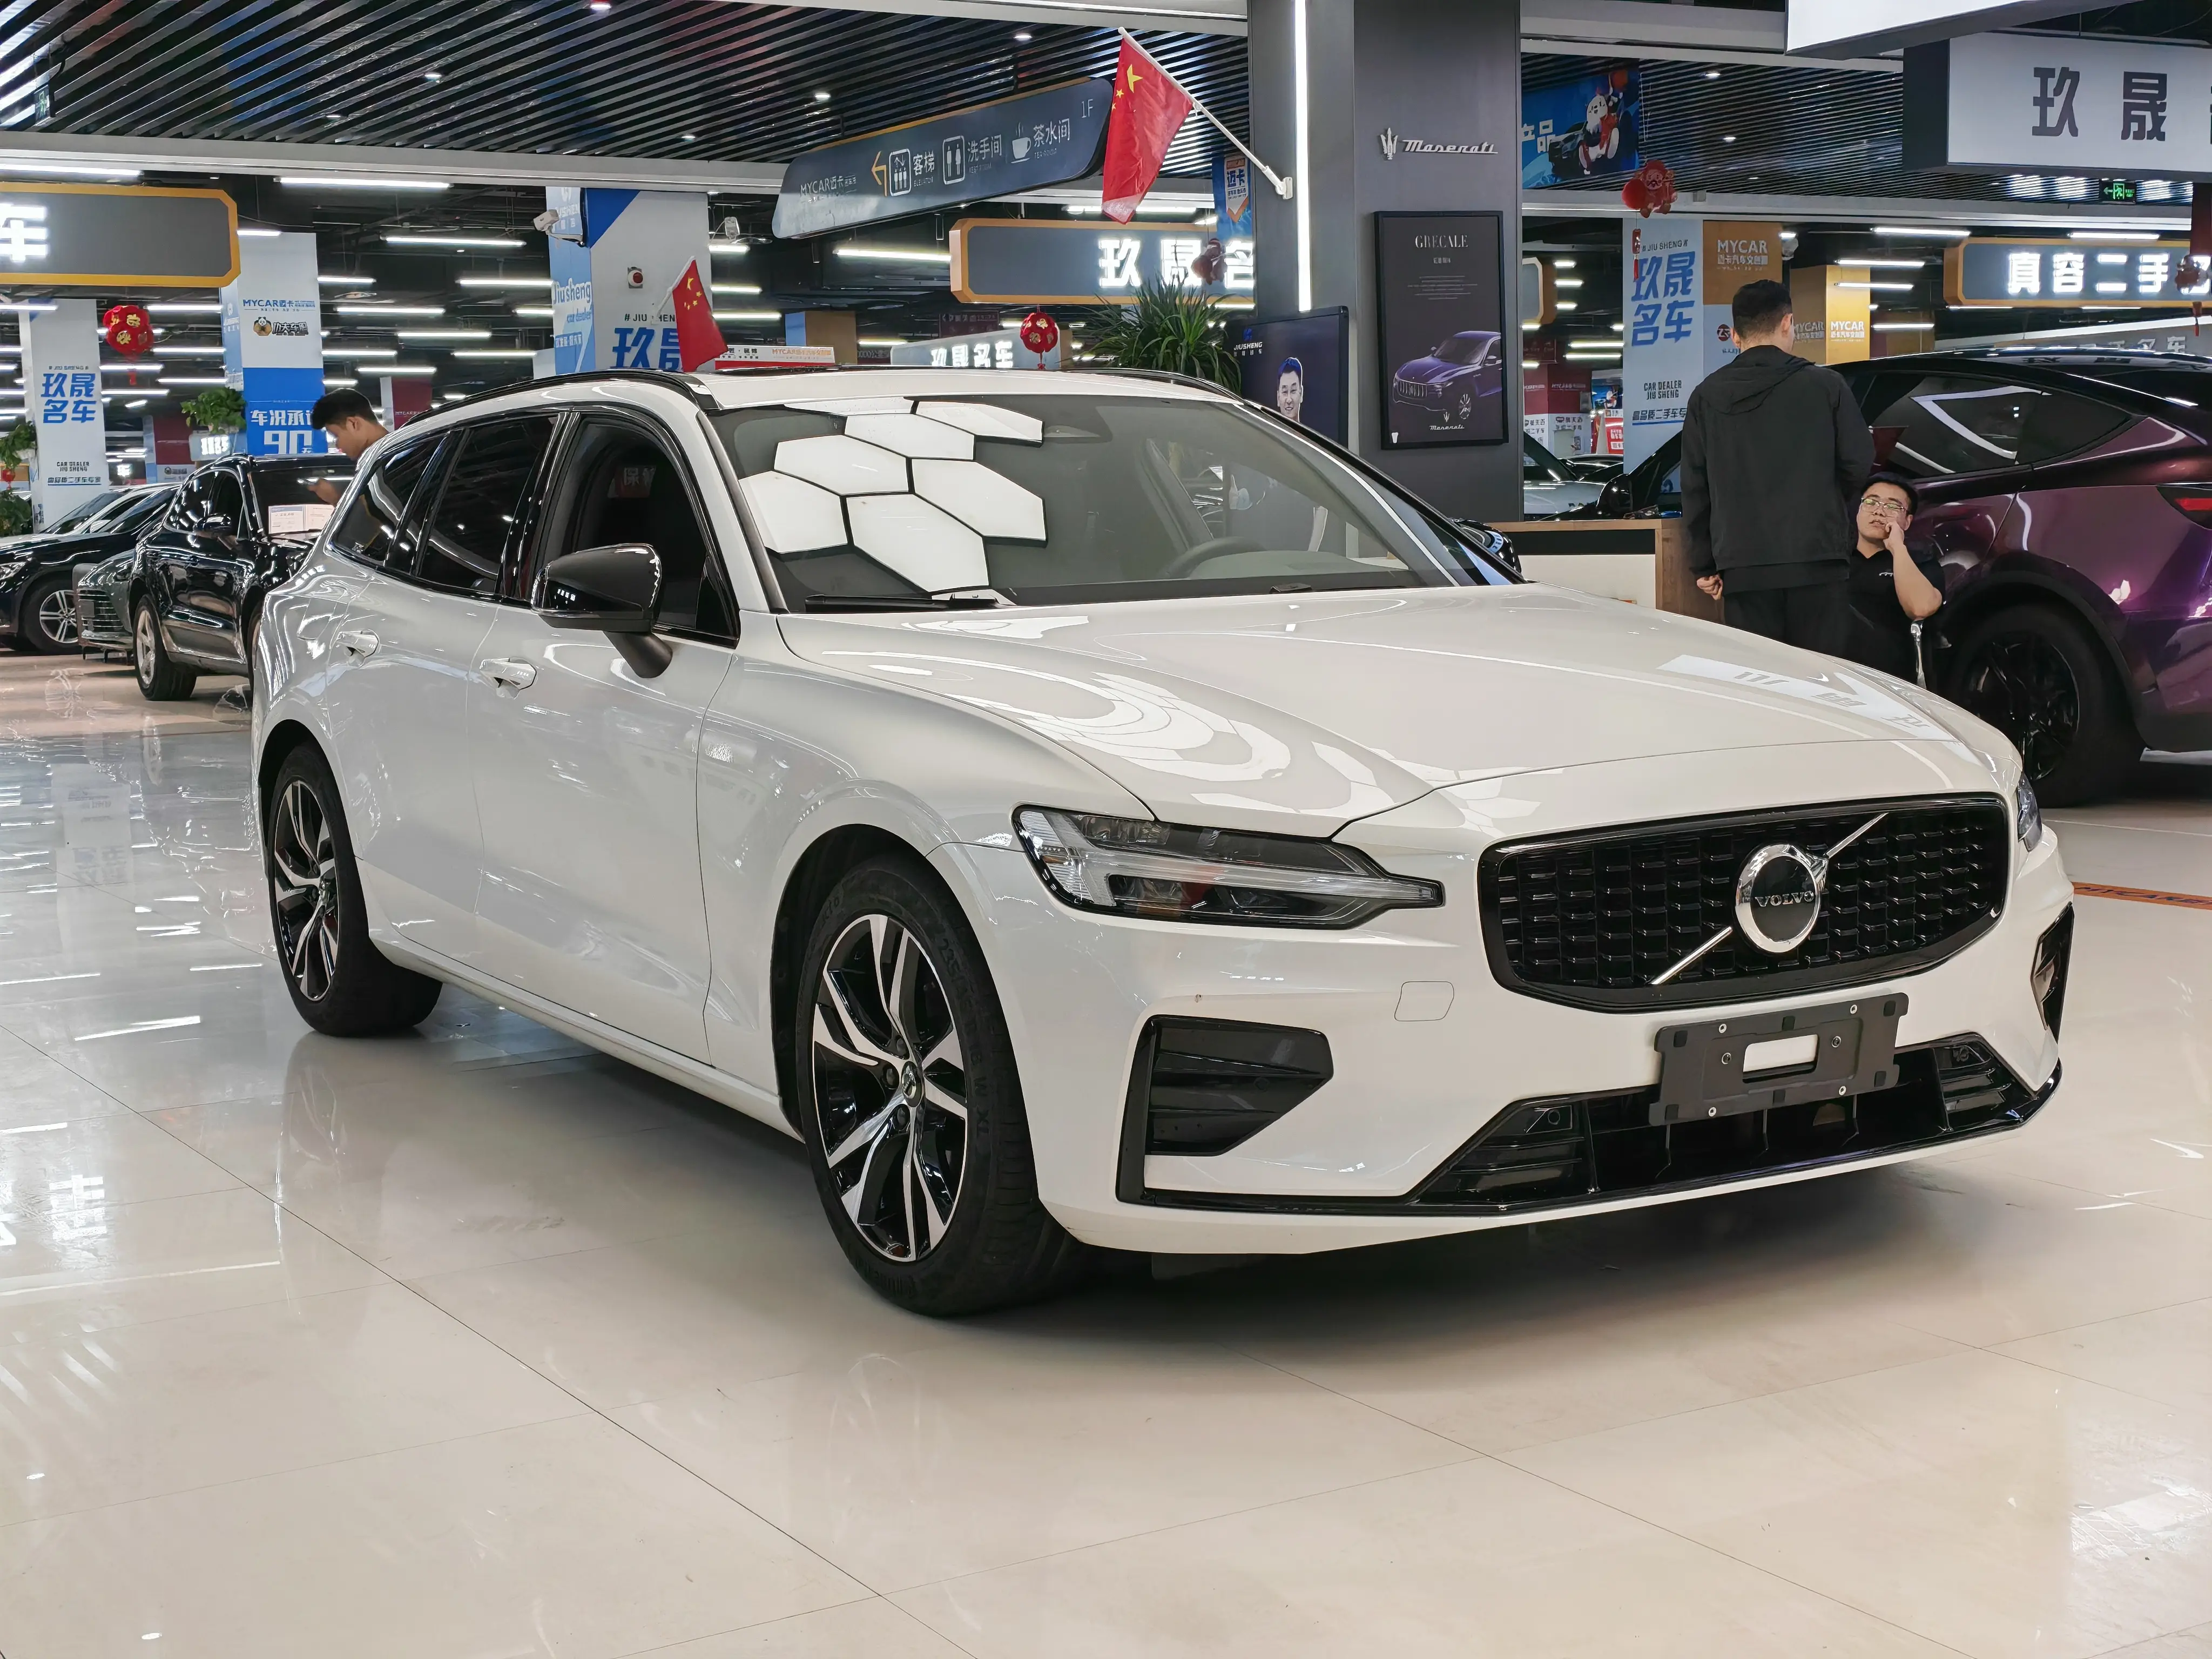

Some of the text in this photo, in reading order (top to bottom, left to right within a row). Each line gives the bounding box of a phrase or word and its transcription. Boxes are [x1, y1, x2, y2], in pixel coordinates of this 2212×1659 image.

[1082, 99, 1093, 118] 1F
[2032, 67, 2212, 143] 玖晟
[1033, 118, 1070, 147] 茶水间
[968, 134, 1002, 163] 洗手间
[1402, 139, 1498, 154] Maserati
[913, 150, 935, 176] 客梯
[1415, 235, 1468, 248] GRECALE
[1648, 243, 1658, 251] JIU
[1660, 239, 1683, 250] SHENG
[1718, 240, 1768, 253] MYCAR
[1631, 251, 1696, 302] 玖晟
[553, 278, 591, 304] Jiusheng
[1631, 300, 1695, 347] 名车
[1831, 321, 1864, 331] MYCAR
[930, 341, 1014, 368] 玖晟名车
[1233, 342, 1263, 350] JIUSHENG
[41, 373, 96, 397] 玖晟
[1644, 380, 1682, 391] CAR DEALER
[1647, 389, 1679, 400] JIU SHENG
[43, 399, 97, 423] 名车
[1755, 890, 1815, 907] VOLVO
